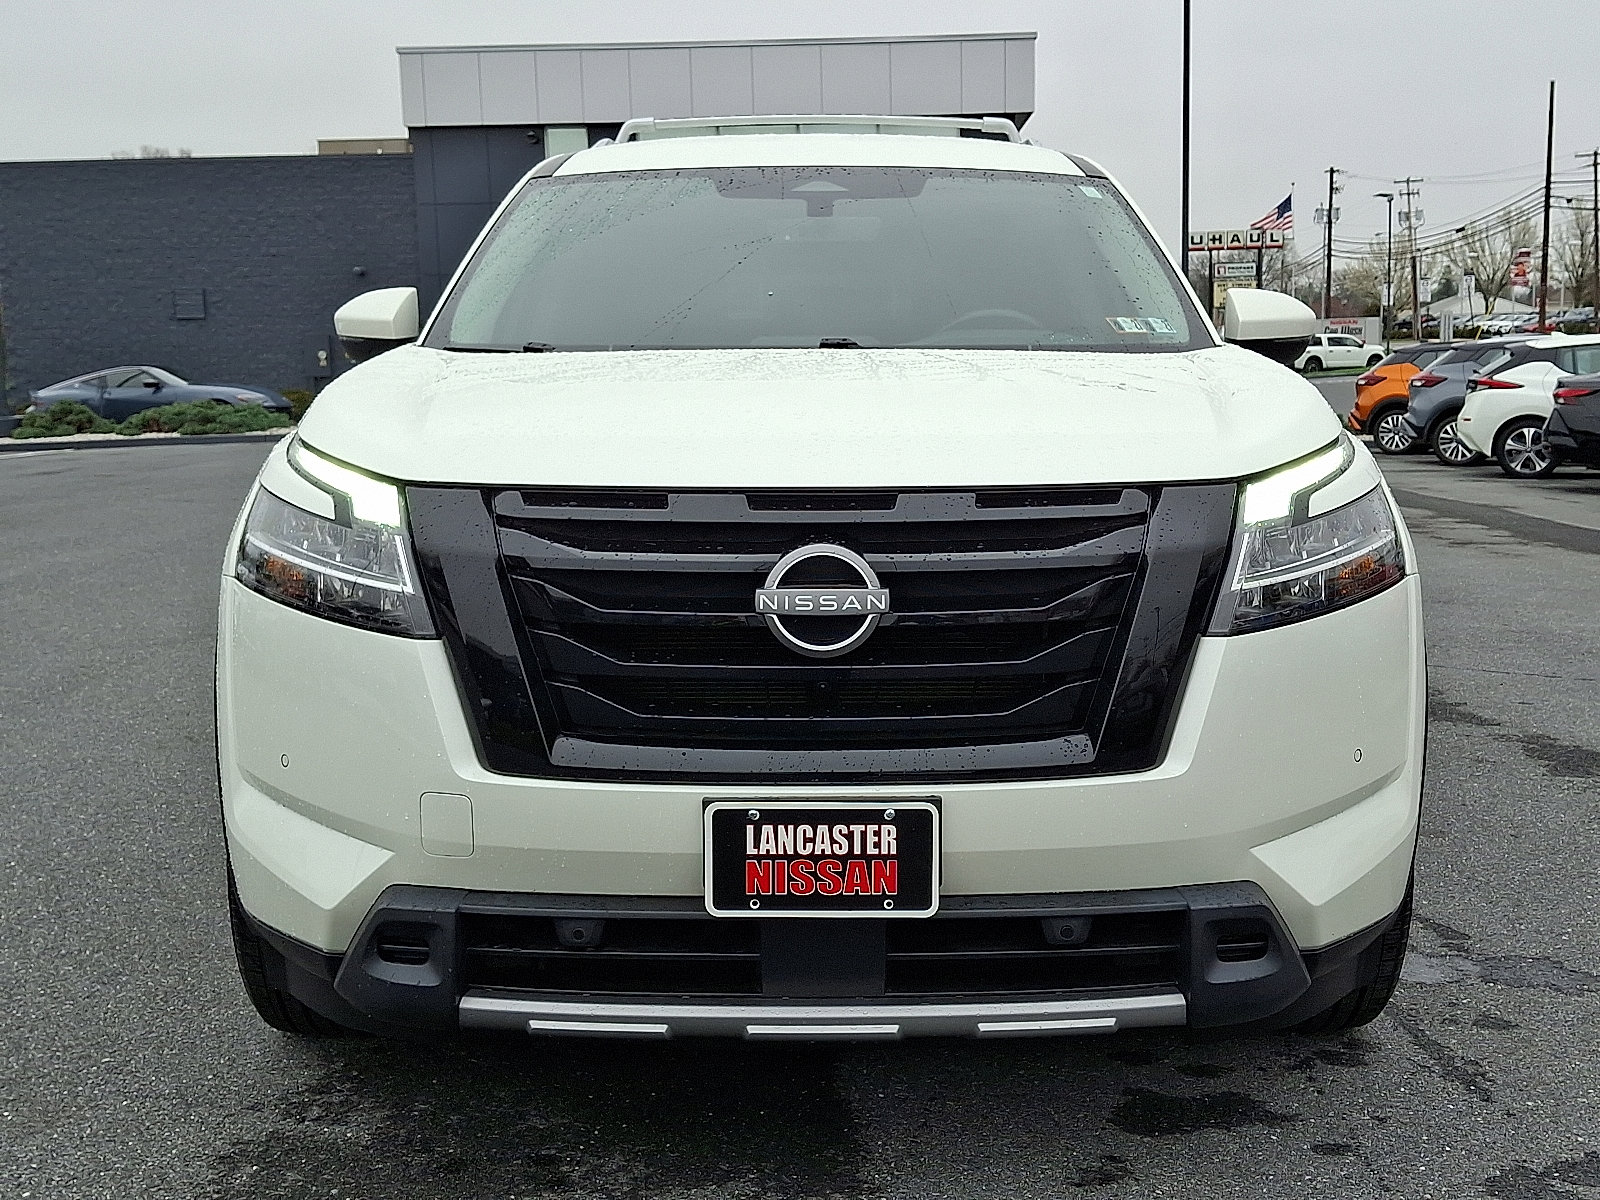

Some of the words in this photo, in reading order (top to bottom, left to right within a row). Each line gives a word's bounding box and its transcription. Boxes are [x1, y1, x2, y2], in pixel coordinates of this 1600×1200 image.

[759, 594, 886, 611] NISSAN
[745, 824, 897, 855] LANCASTER
[745, 859, 898, 896] NISSAN
